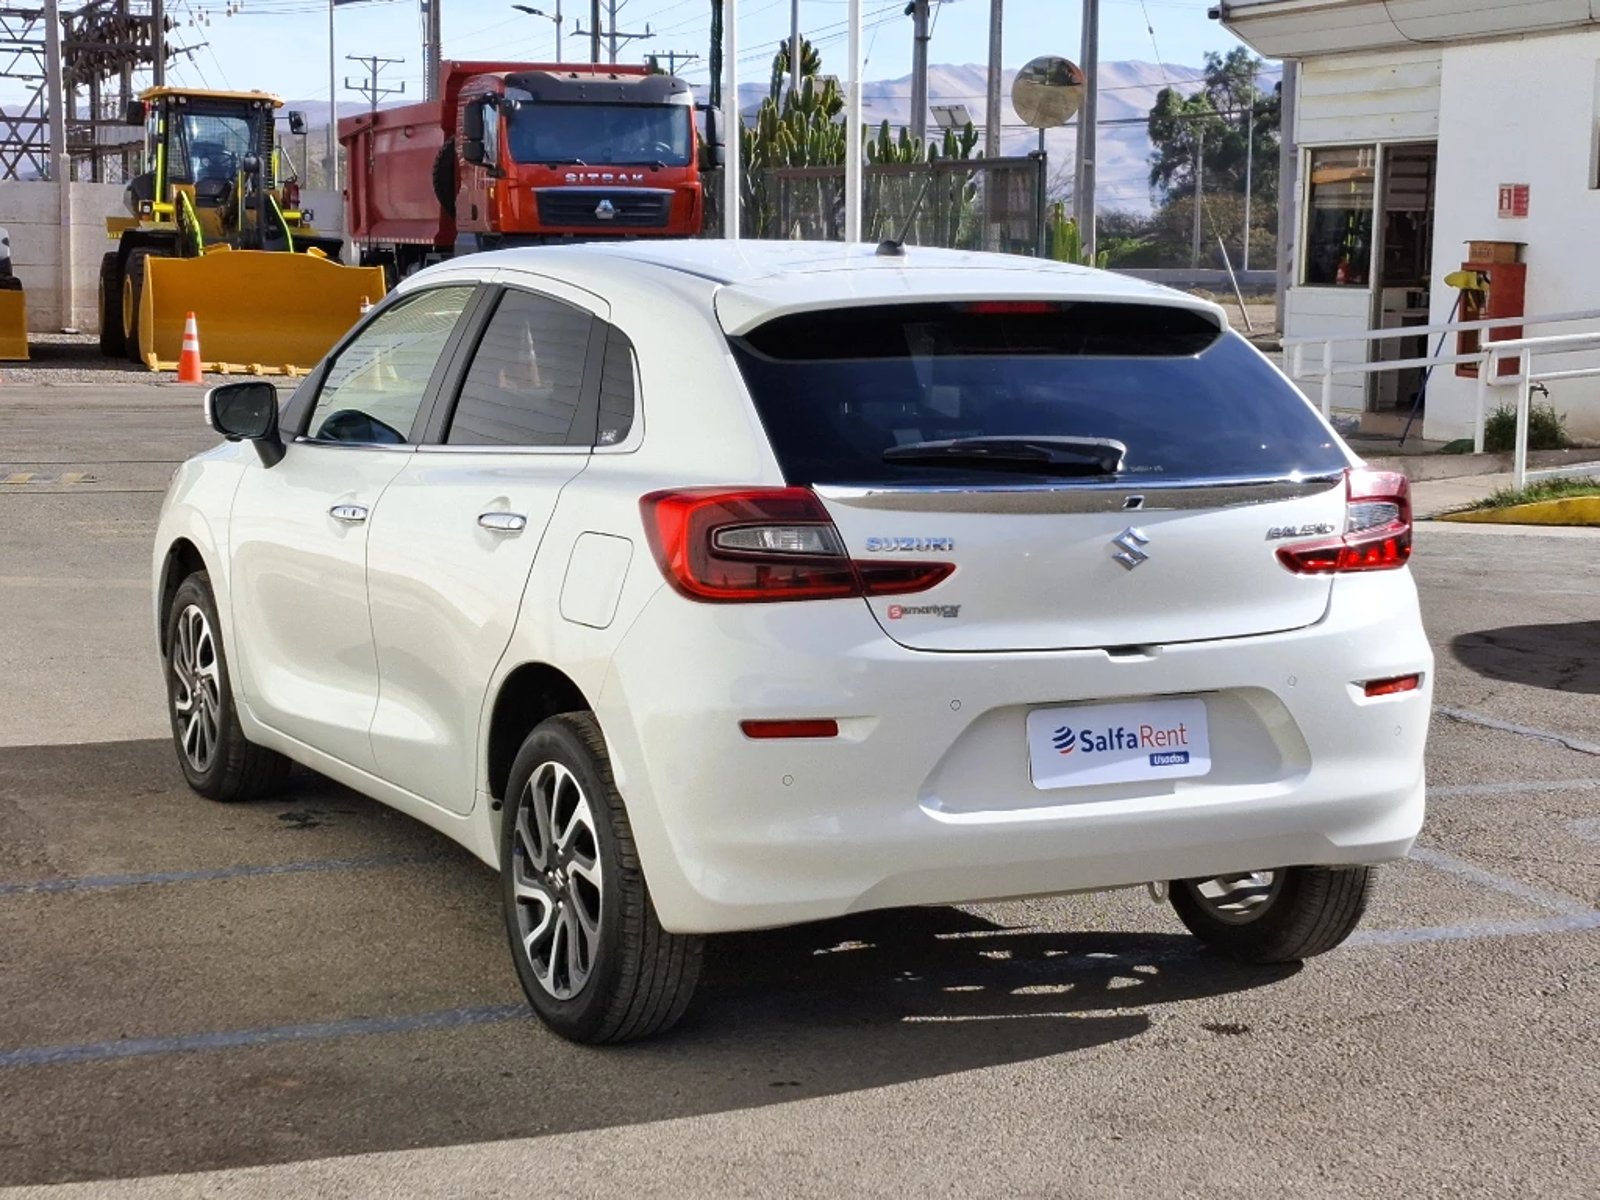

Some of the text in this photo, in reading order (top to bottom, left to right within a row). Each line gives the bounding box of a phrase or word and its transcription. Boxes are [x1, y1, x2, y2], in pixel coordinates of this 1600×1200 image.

[866, 537, 955, 552] SUZUKI
[1080, 722, 1188, 753] SalfaRent
[1154, 753, 1185, 765] Usados
